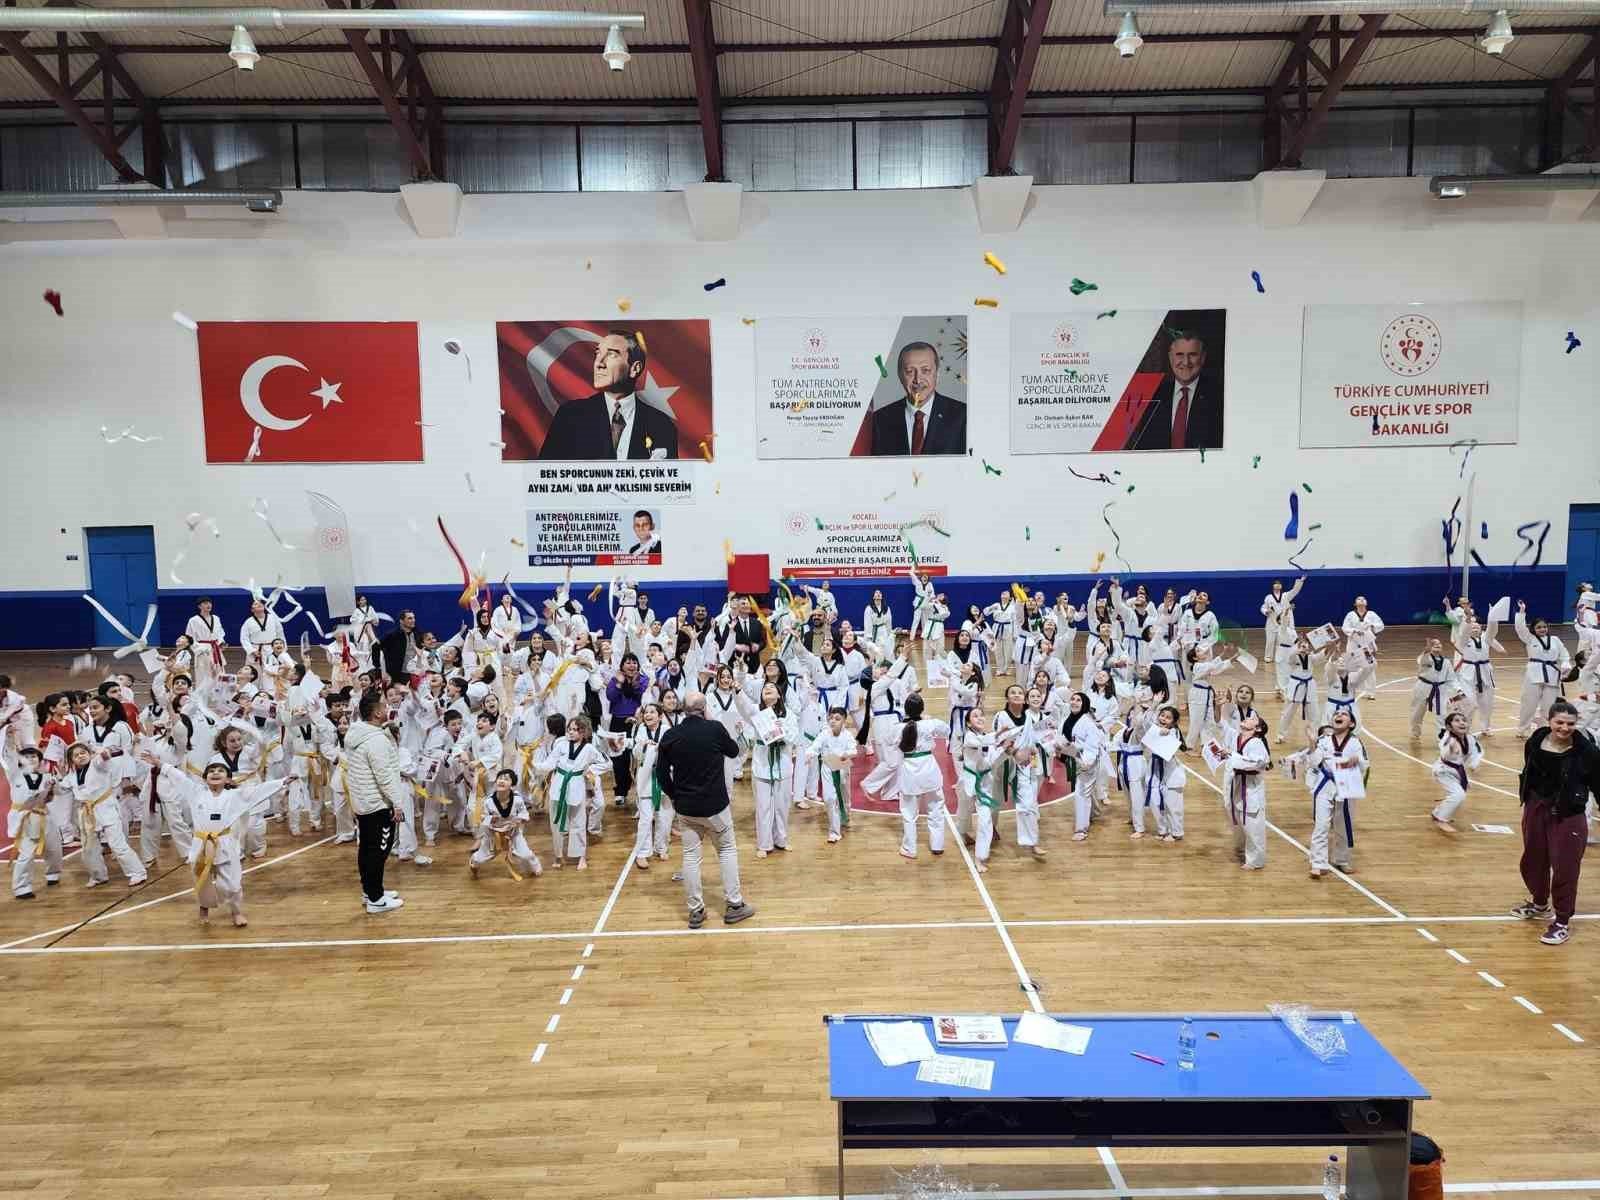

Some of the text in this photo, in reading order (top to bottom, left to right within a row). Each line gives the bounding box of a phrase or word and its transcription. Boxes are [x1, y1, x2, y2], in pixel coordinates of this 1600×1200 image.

[772, 378, 859, 389] TÜM ANTRENÖR VE
[1021, 374, 1109, 384] TÜM ANTRENÖR VE
[774, 389, 857, 399] SPORCULARIMIZA
[1023, 385, 1106, 394] SPORCULARIMIZA
[1334, 381, 1489, 398] TÜRKİYE CUMHURİYETİ
[816, 400, 862, 409] DİLİYORUM
[1018, 395, 1111, 406] BAŞARILAR DİLİYORUM
[1350, 402, 1472, 419] GENÇLİK VE SPOR
[540, 466, 678, 480] BEN SPORCUNUN ZEKİ, ÇEVİK VE
[528, 484, 549, 493] AYNI
[654, 480, 692, 492] SEVERİM
[542, 523, 616, 532] SPORCULARIMIZA
[538, 532, 621, 543] VE HAKEMLERİMİZE
[826, 535, 902, 543] SPORCULARIMIZA
[536, 543, 583, 554] BAŞARILAR
[816, 545, 901, 554] ANTRENÖRLERİMİZE
[787, 556, 857, 565] HAKEMLERİMİZE
[858, 556, 905, 566] BAŞARILAR
[838, 567, 892, 577] HOŞ GELDİNİZ
